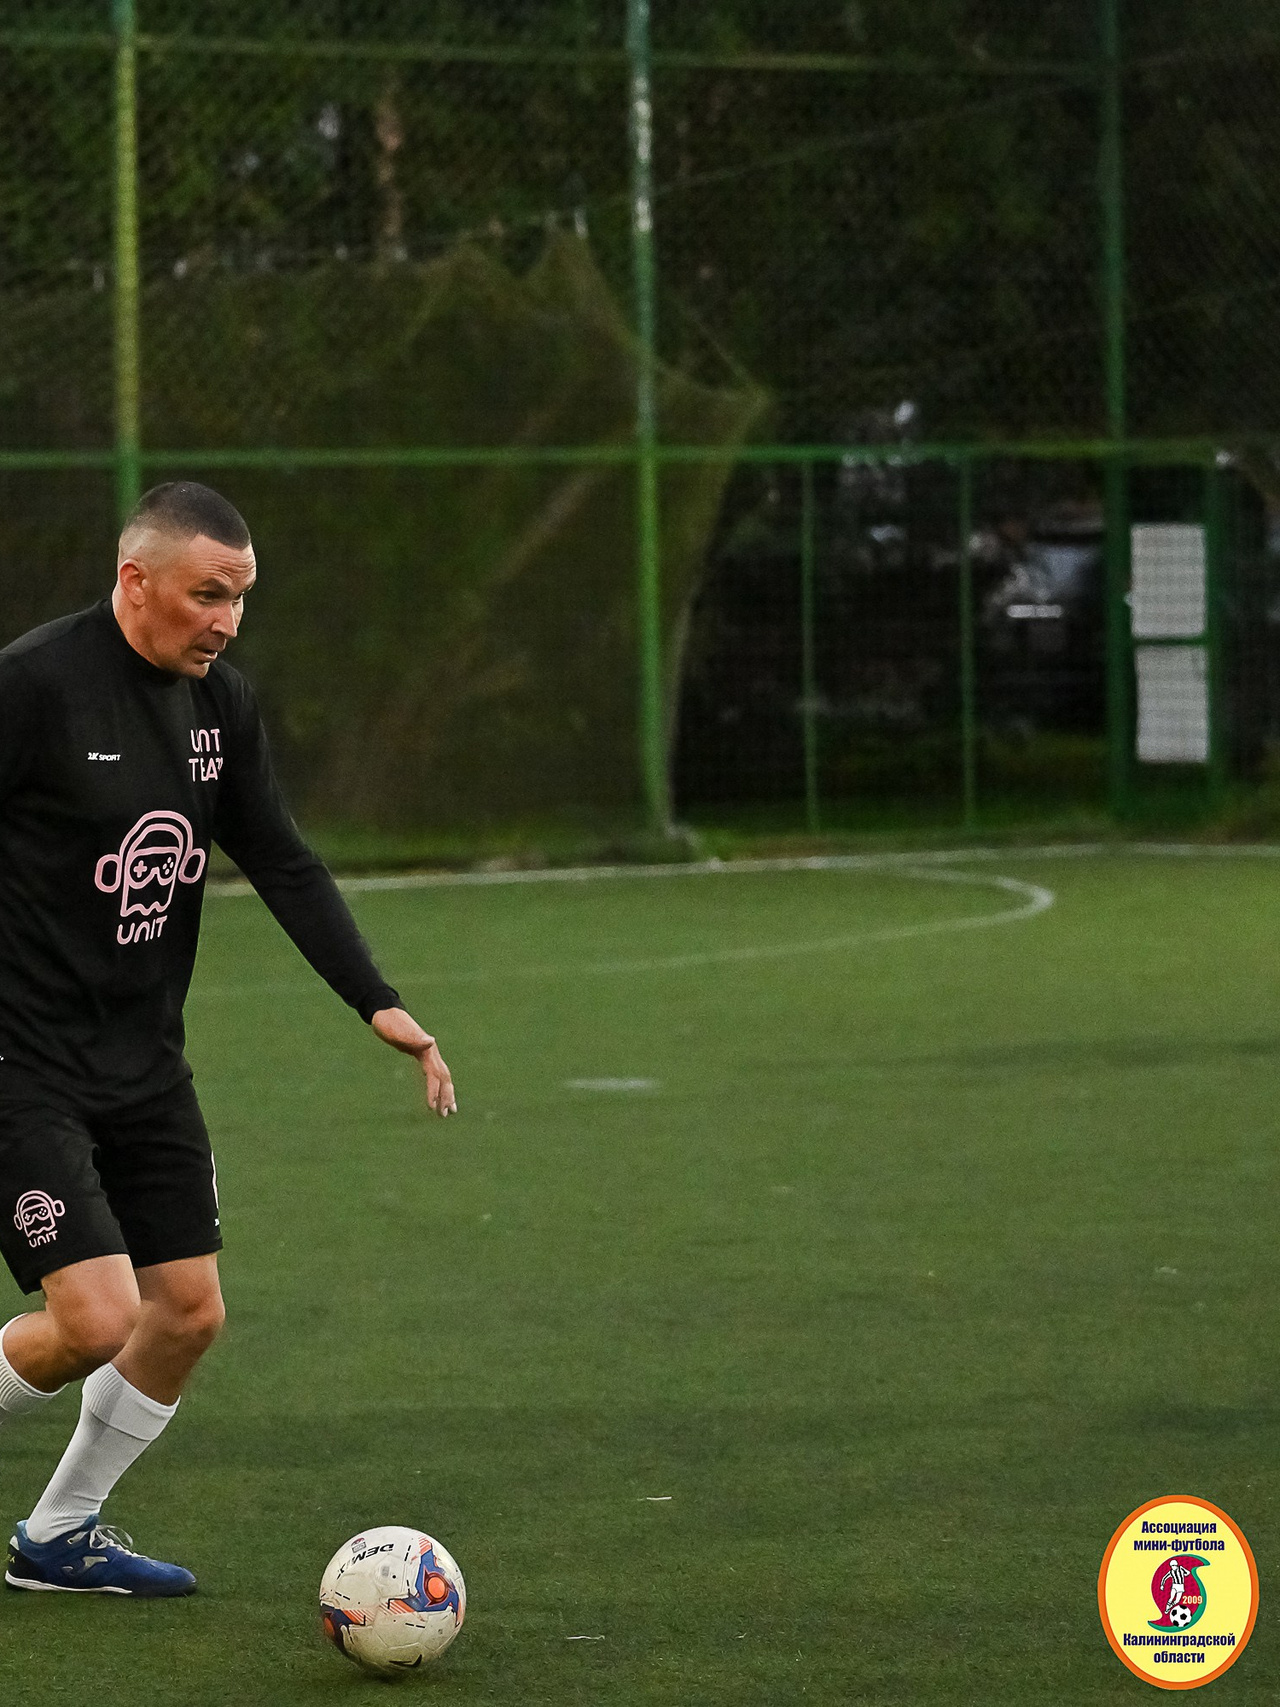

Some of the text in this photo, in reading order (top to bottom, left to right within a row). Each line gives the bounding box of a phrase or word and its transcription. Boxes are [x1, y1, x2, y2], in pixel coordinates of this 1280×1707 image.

[190, 728, 220, 752] UNT
[116, 915, 168, 945] UNIT
[28, 1230, 58, 1248] UNIT
